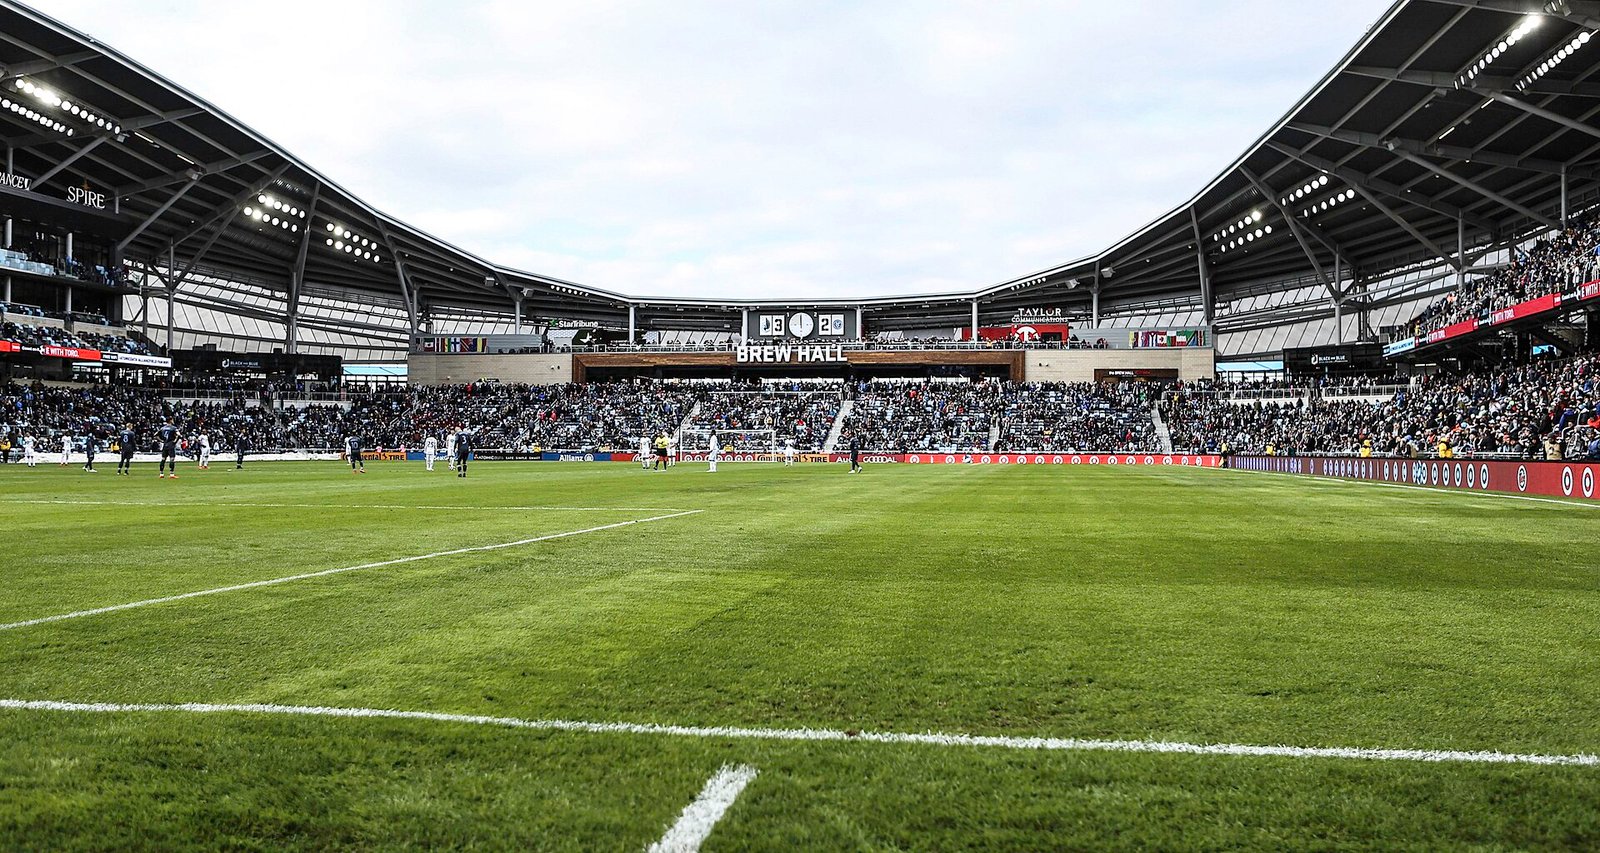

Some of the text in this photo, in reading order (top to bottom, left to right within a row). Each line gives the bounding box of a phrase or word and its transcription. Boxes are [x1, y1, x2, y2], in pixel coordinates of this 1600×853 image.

[0, 172, 24, 188] ANCE
[66, 186, 105, 209] SPIRE
[1018, 308, 1062, 317] TAYLOR
[559, 320, 599, 328] StarTribune
[774, 319, 782, 331] 3
[821, 319, 829, 331] 2
[50, 348, 64, 356] WITH
[737, 344, 847, 362] BREW HALL
[123, 434, 129, 443] 8
[164, 430, 169, 440] 4
[462, 435, 468, 444] 3
[351, 441, 359, 449] 10
[559, 454, 584, 462] Allianz
